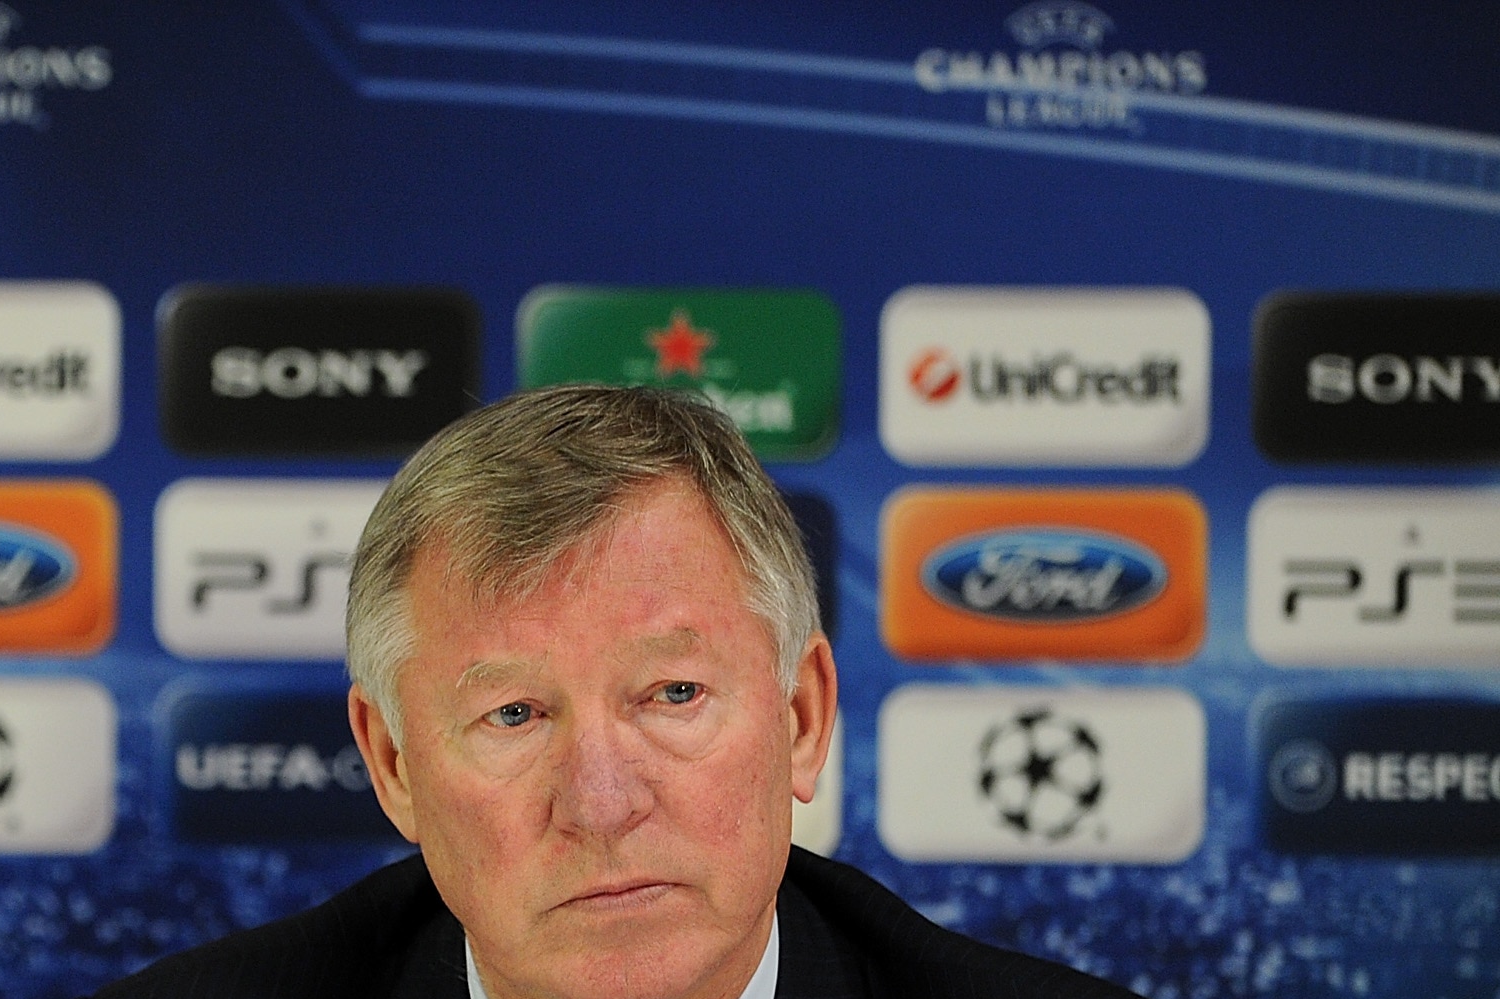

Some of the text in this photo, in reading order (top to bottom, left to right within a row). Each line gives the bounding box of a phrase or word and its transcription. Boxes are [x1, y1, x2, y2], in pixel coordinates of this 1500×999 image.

[914, 47, 1208, 95] CHAMPIONS
[210, 346, 426, 399] SONY
[968, 350, 1182, 405] UniCredit
[1307, 352, 1500, 404] SONY
[189, 550, 354, 616] PS
[962, 542, 1124, 611] Ford
[1343, 752, 1500, 802] RESPE
